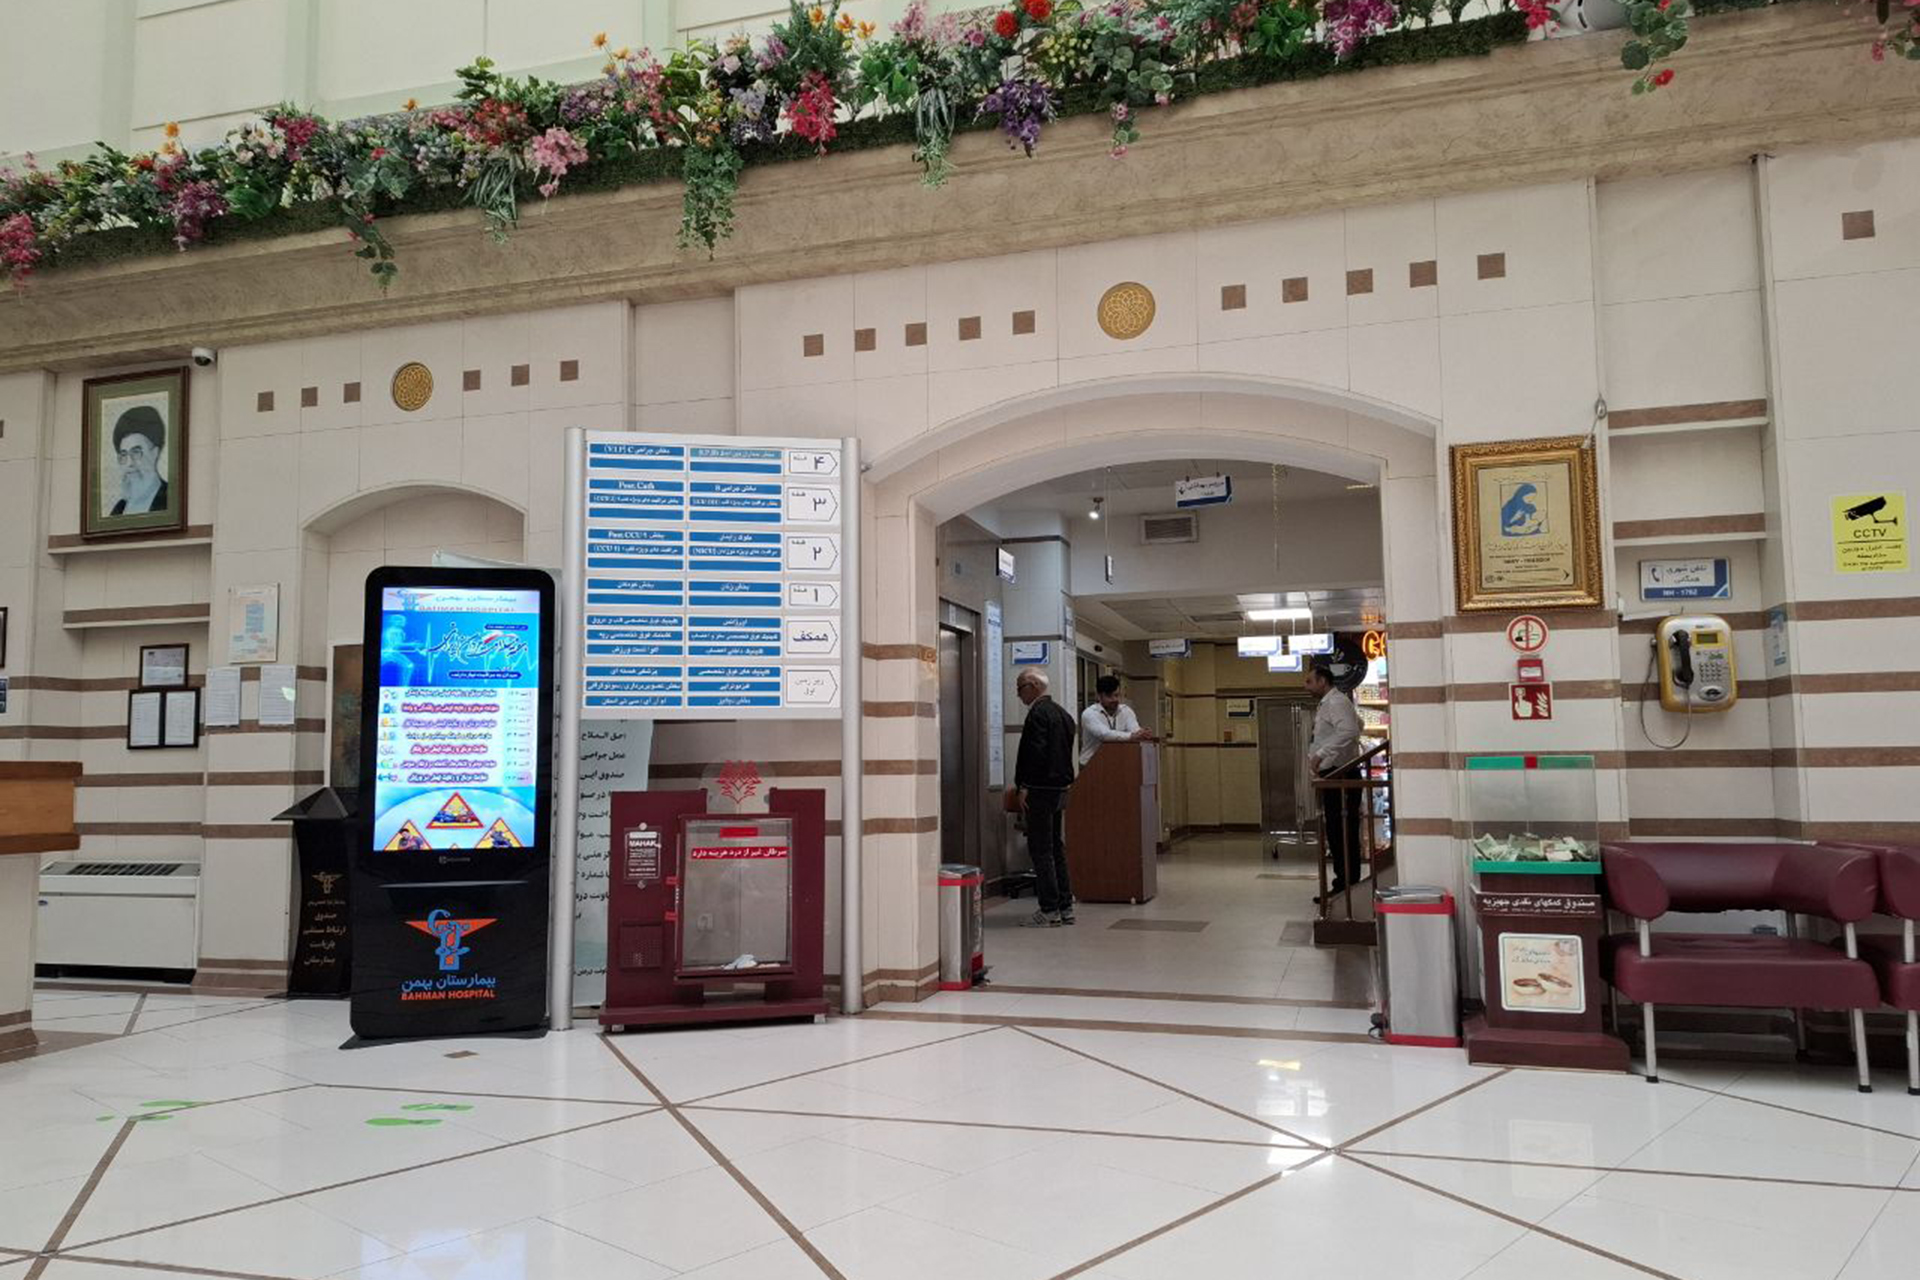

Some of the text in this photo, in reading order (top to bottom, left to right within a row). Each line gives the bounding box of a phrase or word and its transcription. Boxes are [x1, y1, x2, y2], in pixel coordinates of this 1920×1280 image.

[812, 497, 827, 512] ۳
[1853, 528, 1887, 539] CCTV
[812, 546, 822, 561] ۲
[792, 630, 829, 642] همکف
[763, 847, 788, 857] سرطان
[1564, 898, 1596, 909] صندوق
[401, 973, 496, 993] بیمارستان بهمن
[401, 988, 496, 1001] BAHMAN HOSPITAL
